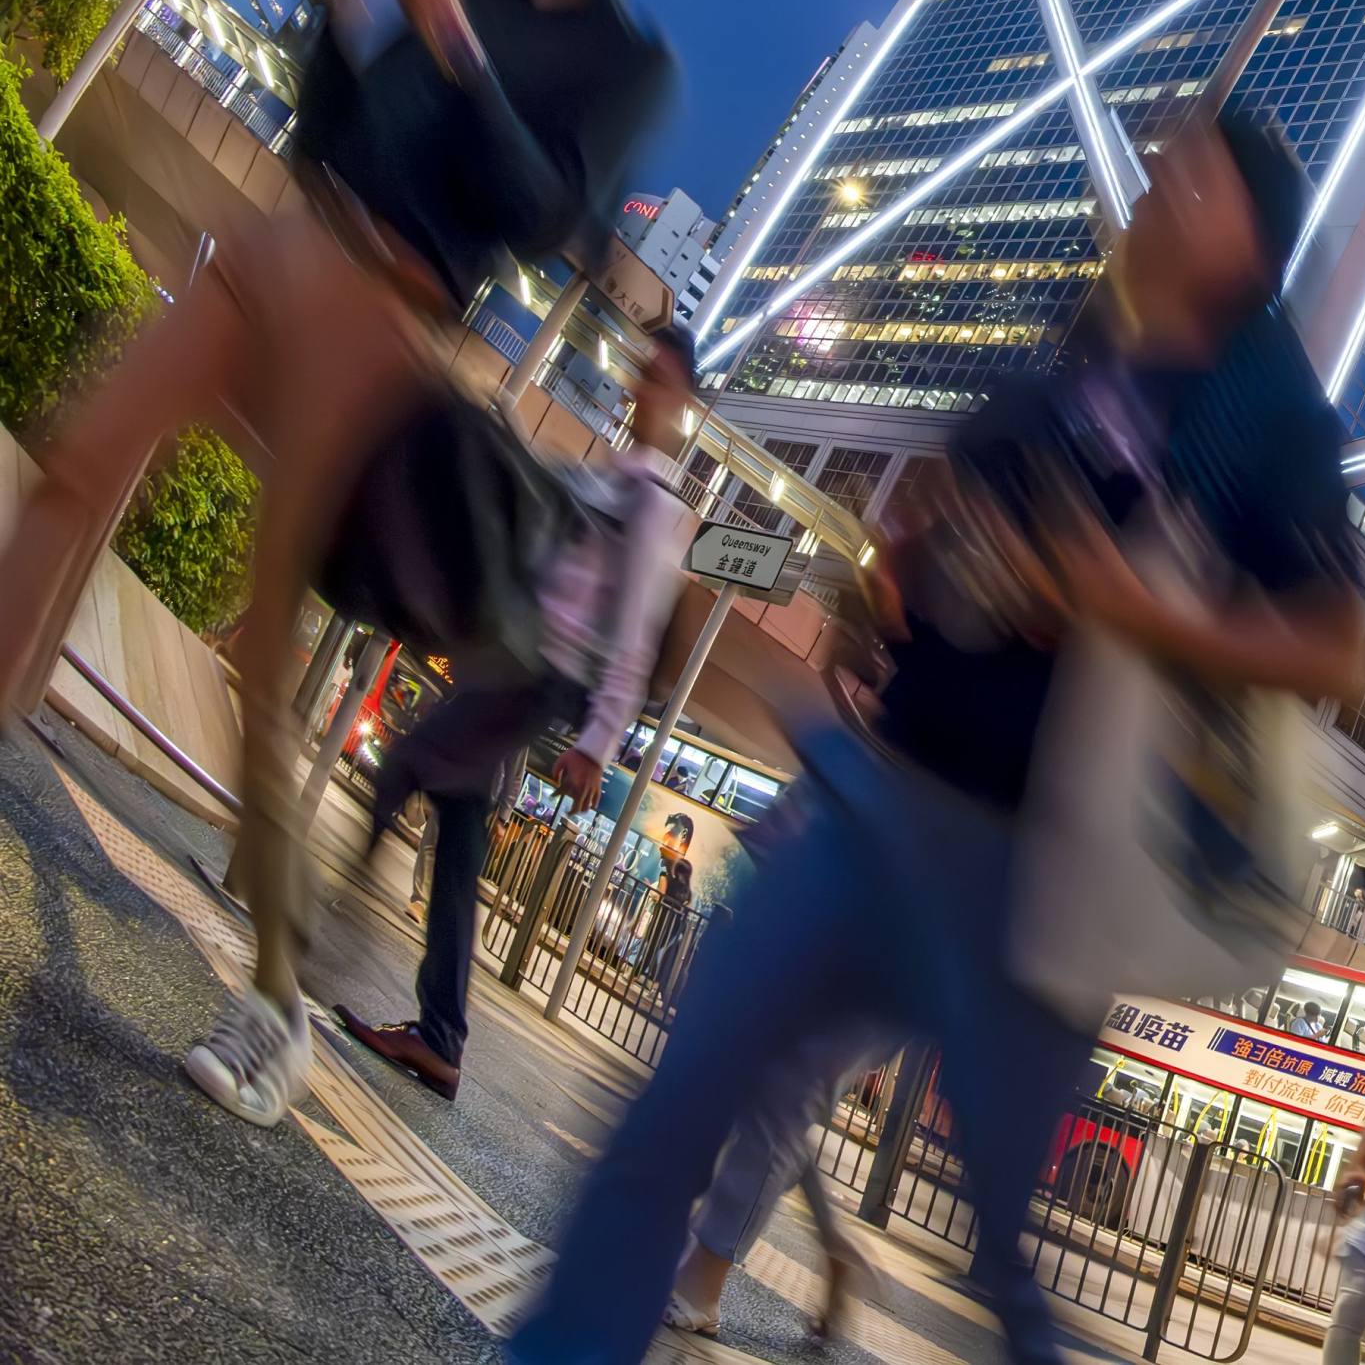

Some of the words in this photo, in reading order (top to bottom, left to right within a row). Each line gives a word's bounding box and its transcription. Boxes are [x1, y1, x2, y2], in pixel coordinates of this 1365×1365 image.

[722, 534, 771, 556] Queensway
[716, 553, 757, 577] 金鐘道
[1105, 1003, 1195, 1052] 組疫苗
[1242, 1068, 1321, 1106] 對付流感
